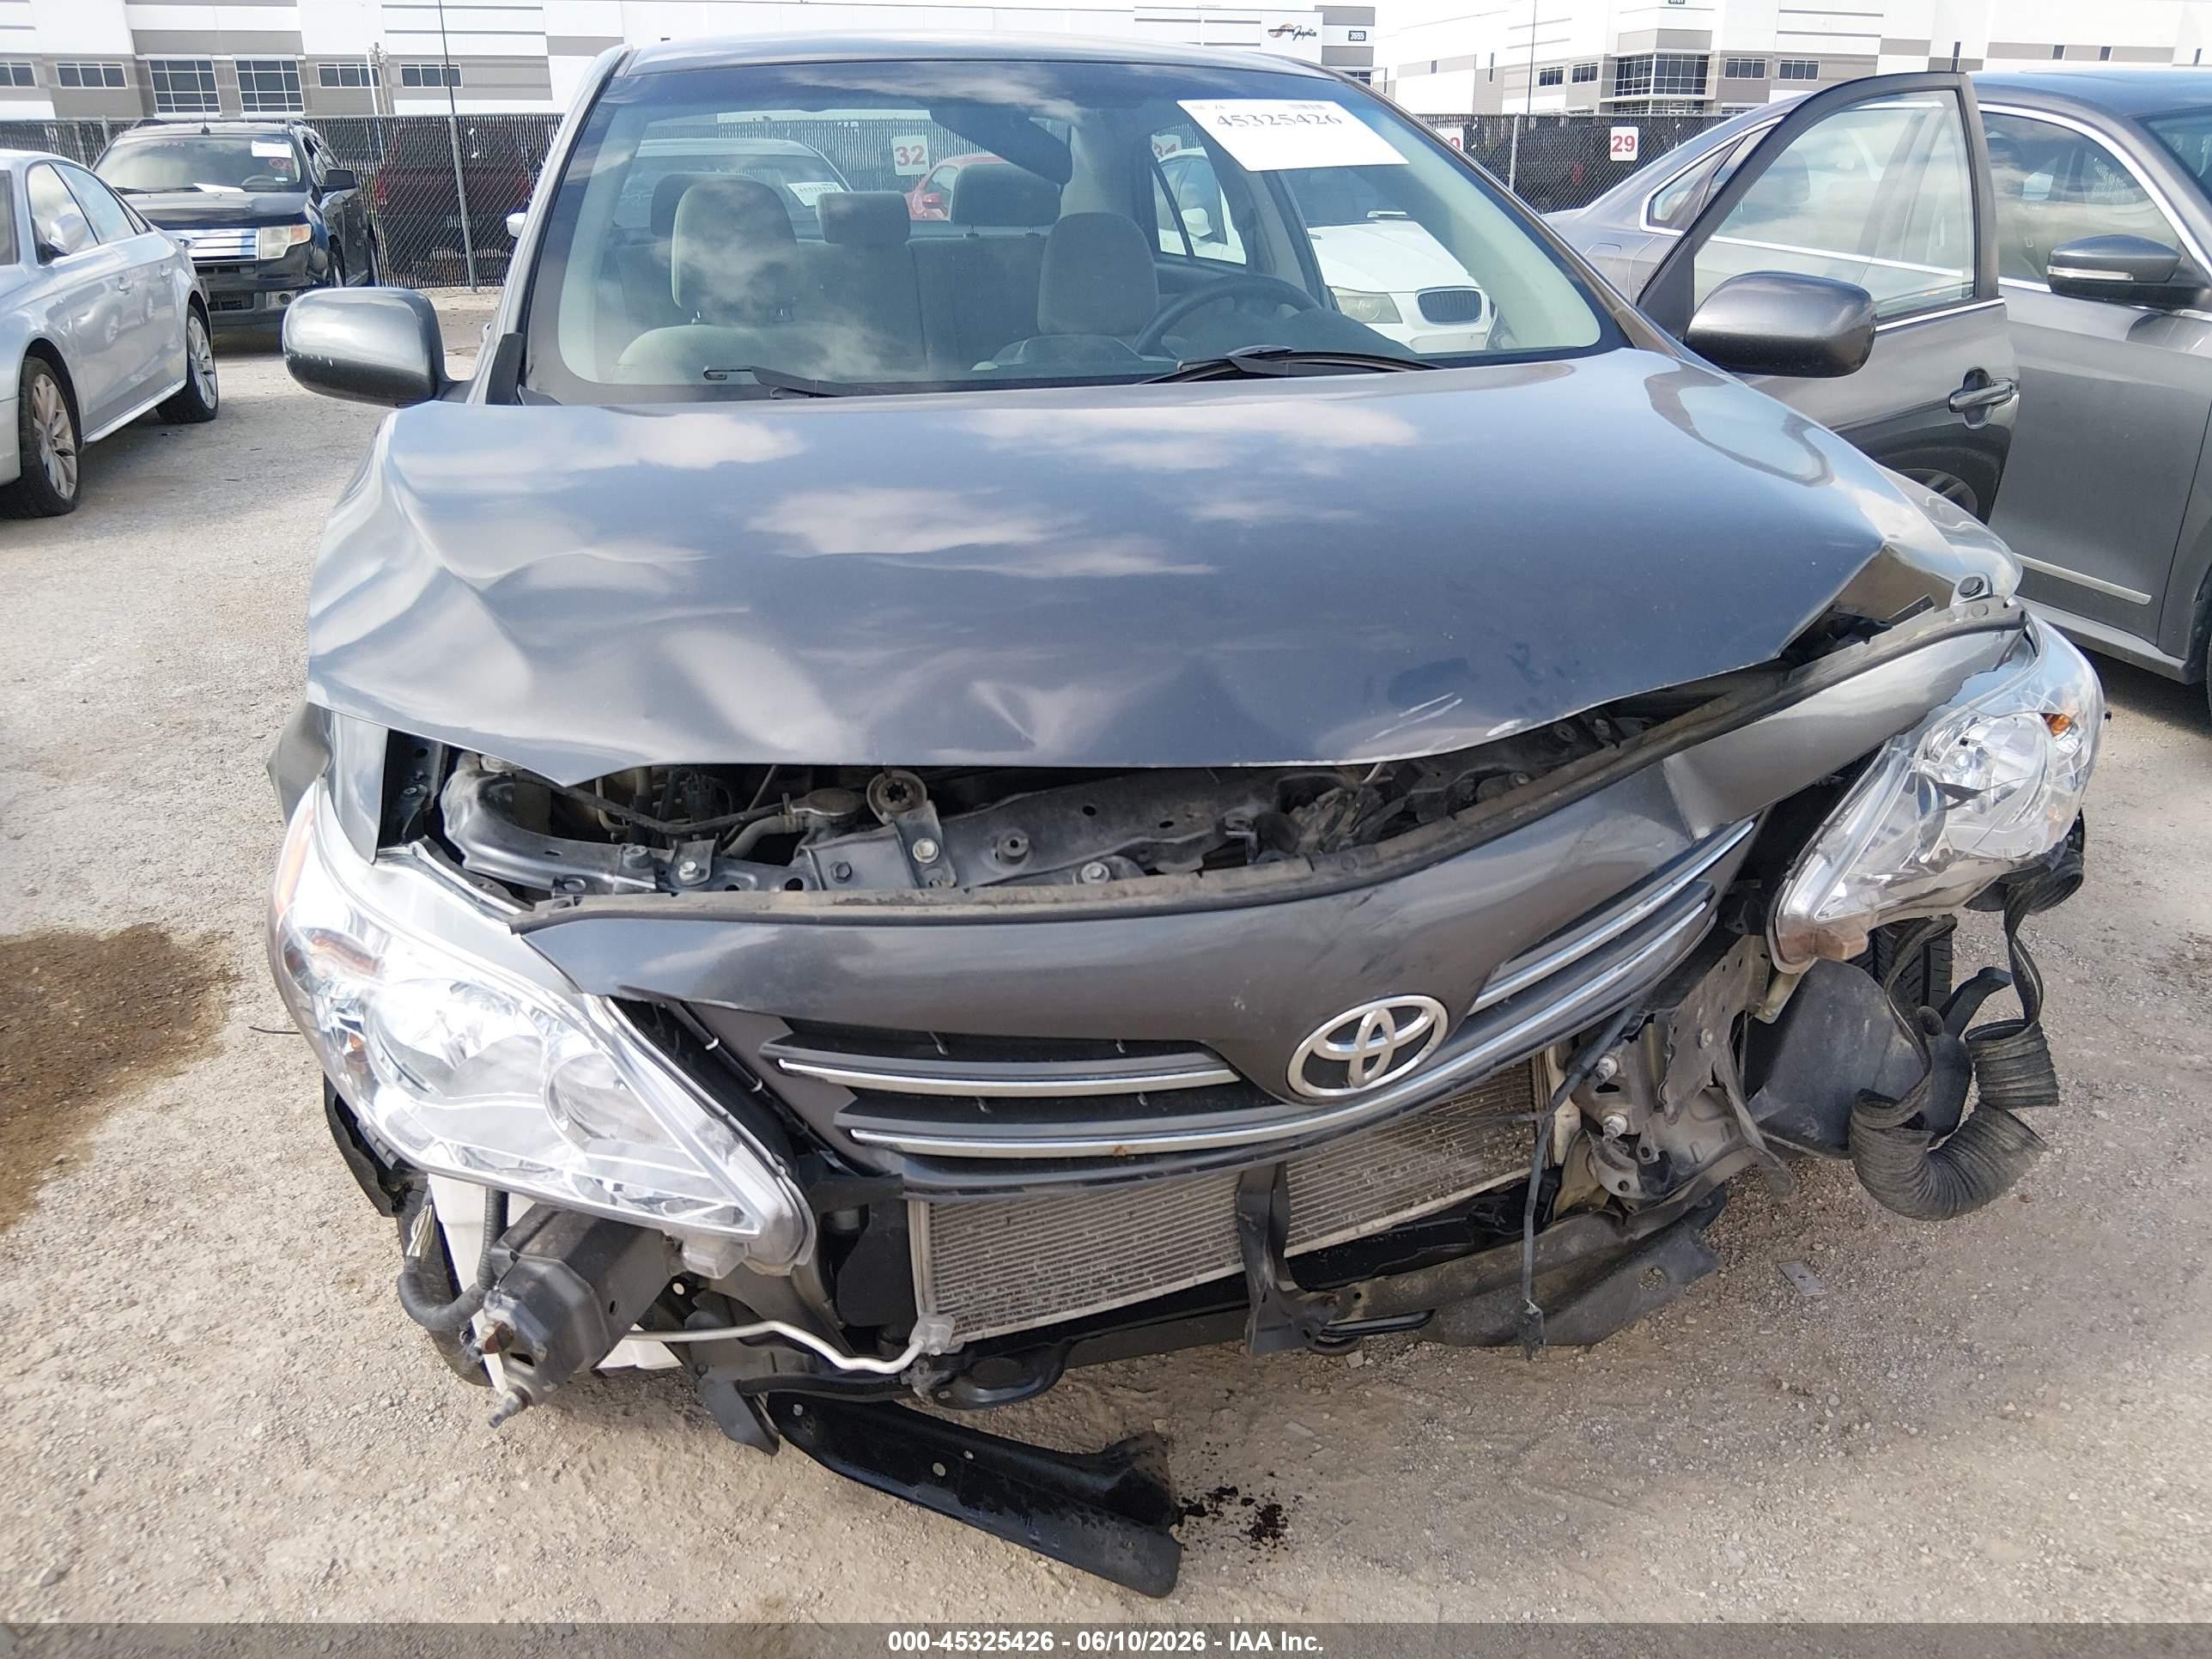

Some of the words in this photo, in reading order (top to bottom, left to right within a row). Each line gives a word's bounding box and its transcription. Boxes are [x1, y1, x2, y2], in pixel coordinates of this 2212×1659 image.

[1218, 113, 1342, 127] 45325426
[1612, 135, 1636, 153] 29
[895, 144, 927, 167] 32
